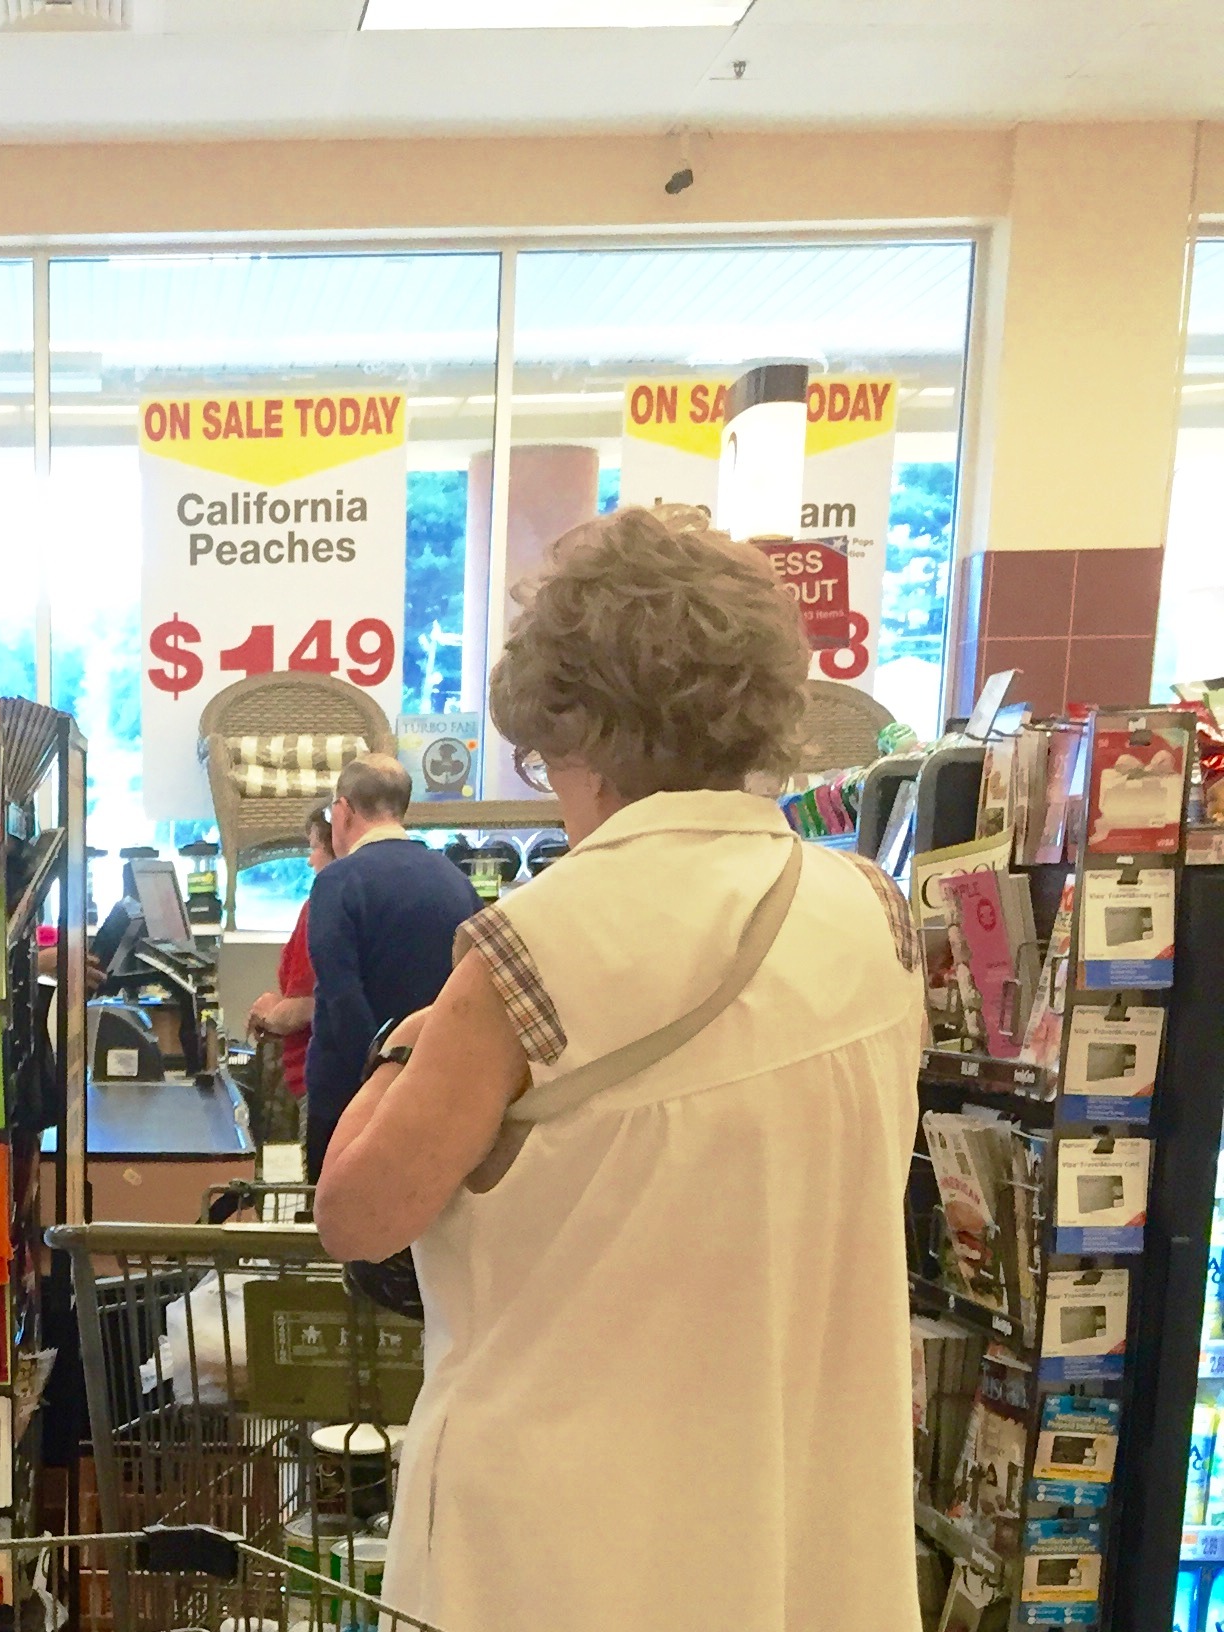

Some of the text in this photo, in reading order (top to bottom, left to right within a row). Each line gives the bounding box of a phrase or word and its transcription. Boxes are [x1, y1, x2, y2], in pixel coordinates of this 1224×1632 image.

[144, 396, 401, 442] ON SALE TODAY
[630, 384, 678, 426] ON
[176, 489, 368, 527] California
[189, 530, 357, 566] Peaches
[403, 721, 448, 734] TURBO
